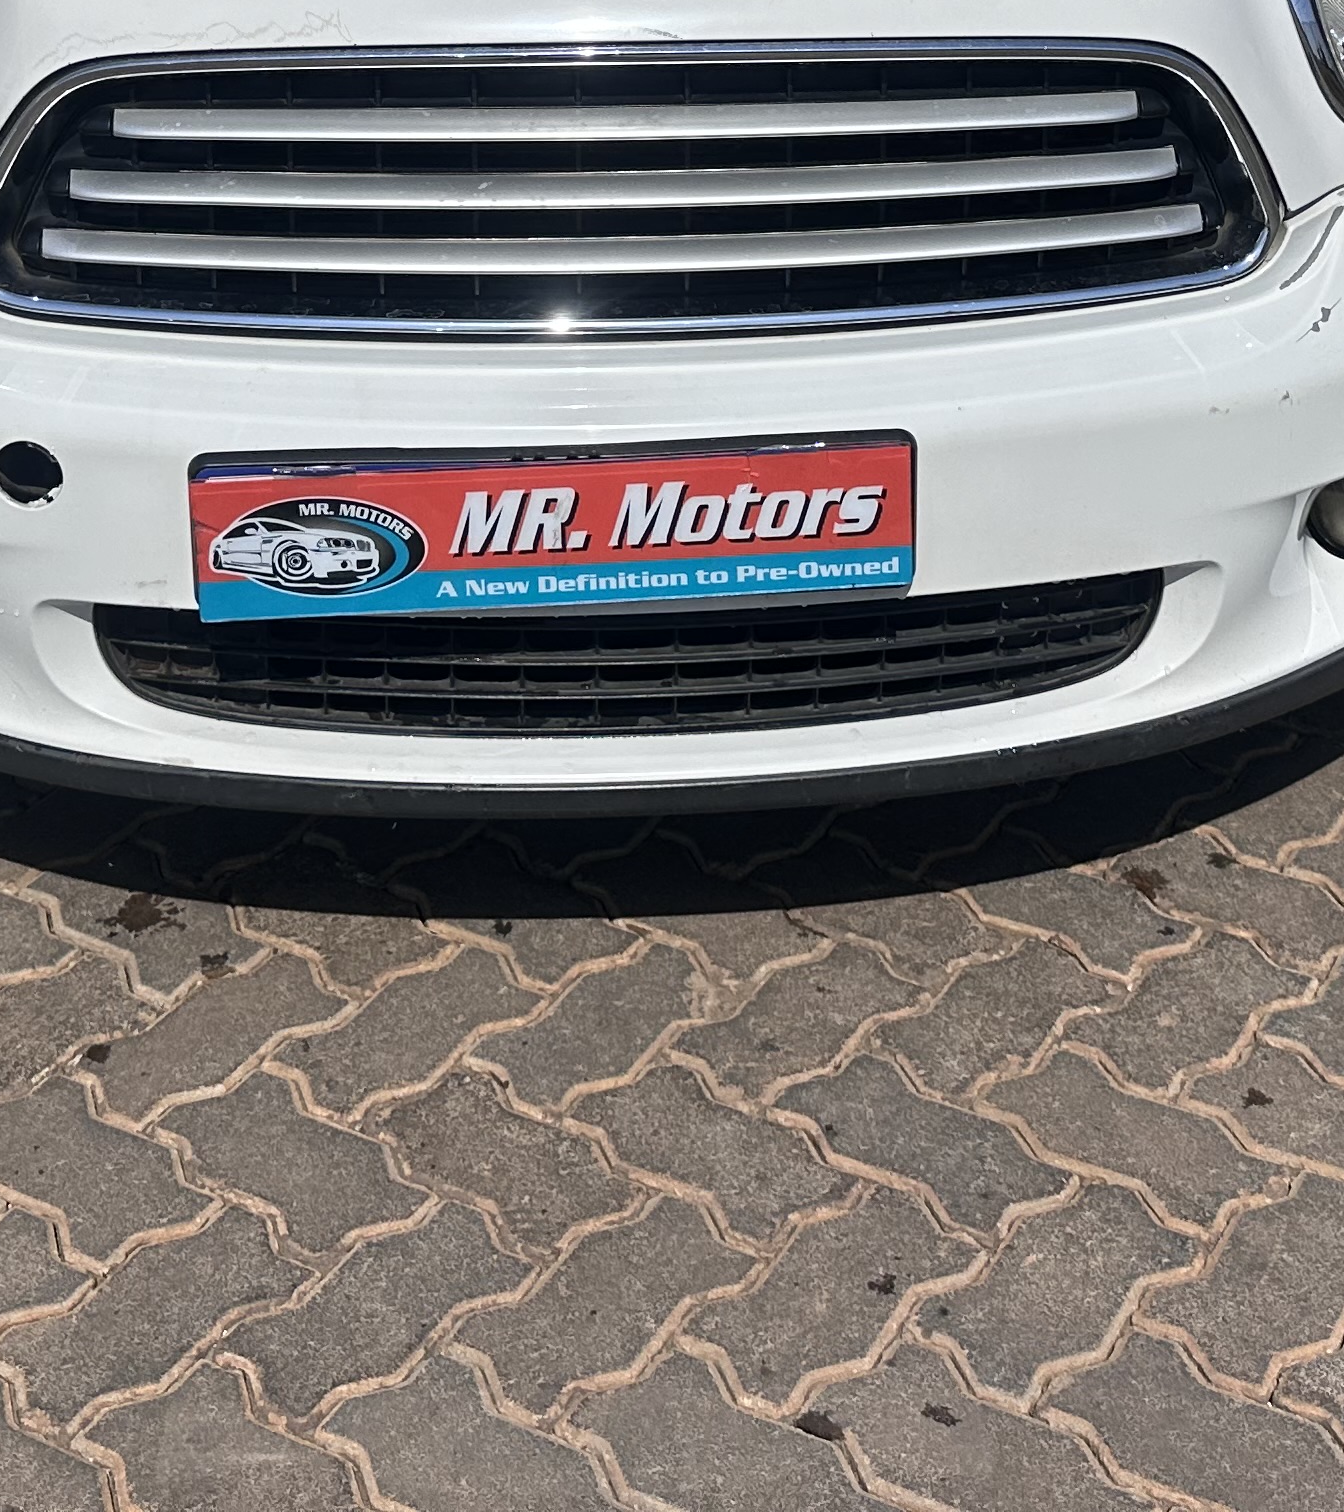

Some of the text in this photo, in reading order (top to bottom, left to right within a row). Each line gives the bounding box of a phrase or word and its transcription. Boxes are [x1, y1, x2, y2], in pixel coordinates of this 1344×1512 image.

[299, 502, 416, 541] MR. MOTORS
[448, 480, 885, 555] MR. Motors
[436, 556, 900, 598] A New Definition to Pre-Owned
